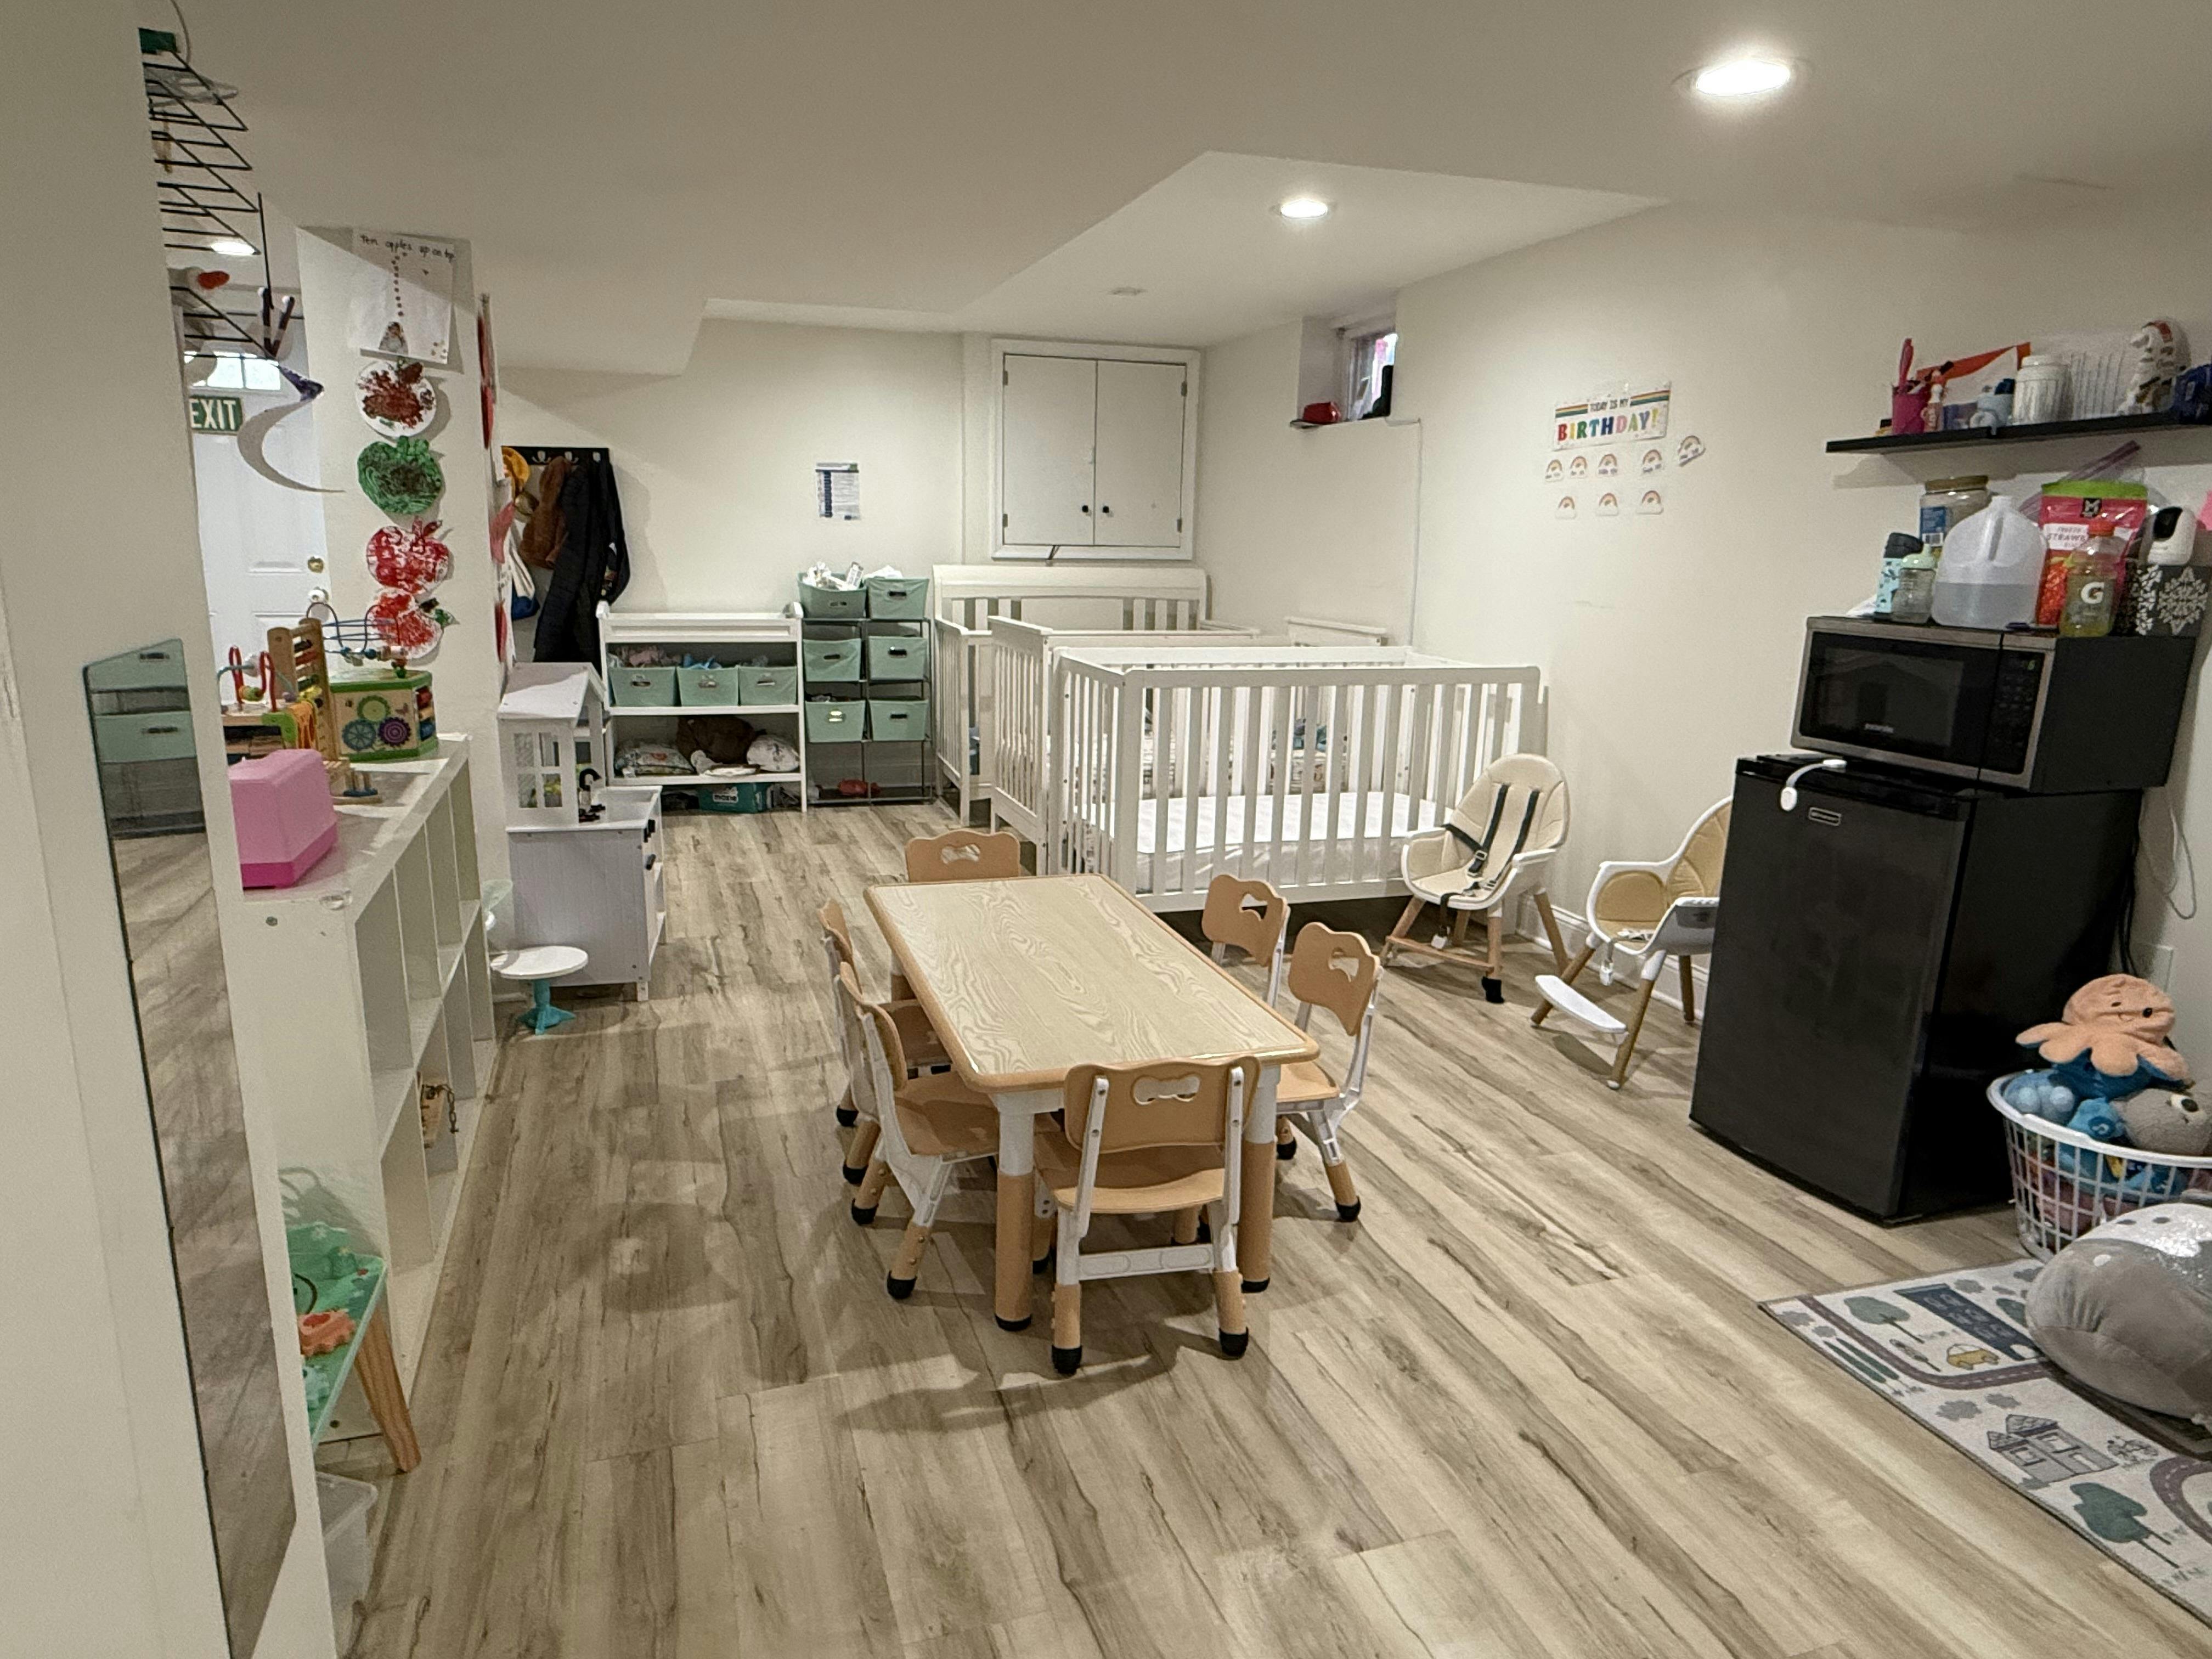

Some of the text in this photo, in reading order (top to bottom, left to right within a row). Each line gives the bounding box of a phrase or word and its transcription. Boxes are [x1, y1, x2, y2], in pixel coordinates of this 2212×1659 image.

[385, 239, 412, 253] apples
[189, 398, 236, 430] EXIT
[1557, 408, 1660, 441] BIRTHDAY!
[2080, 582, 2105, 604] G
